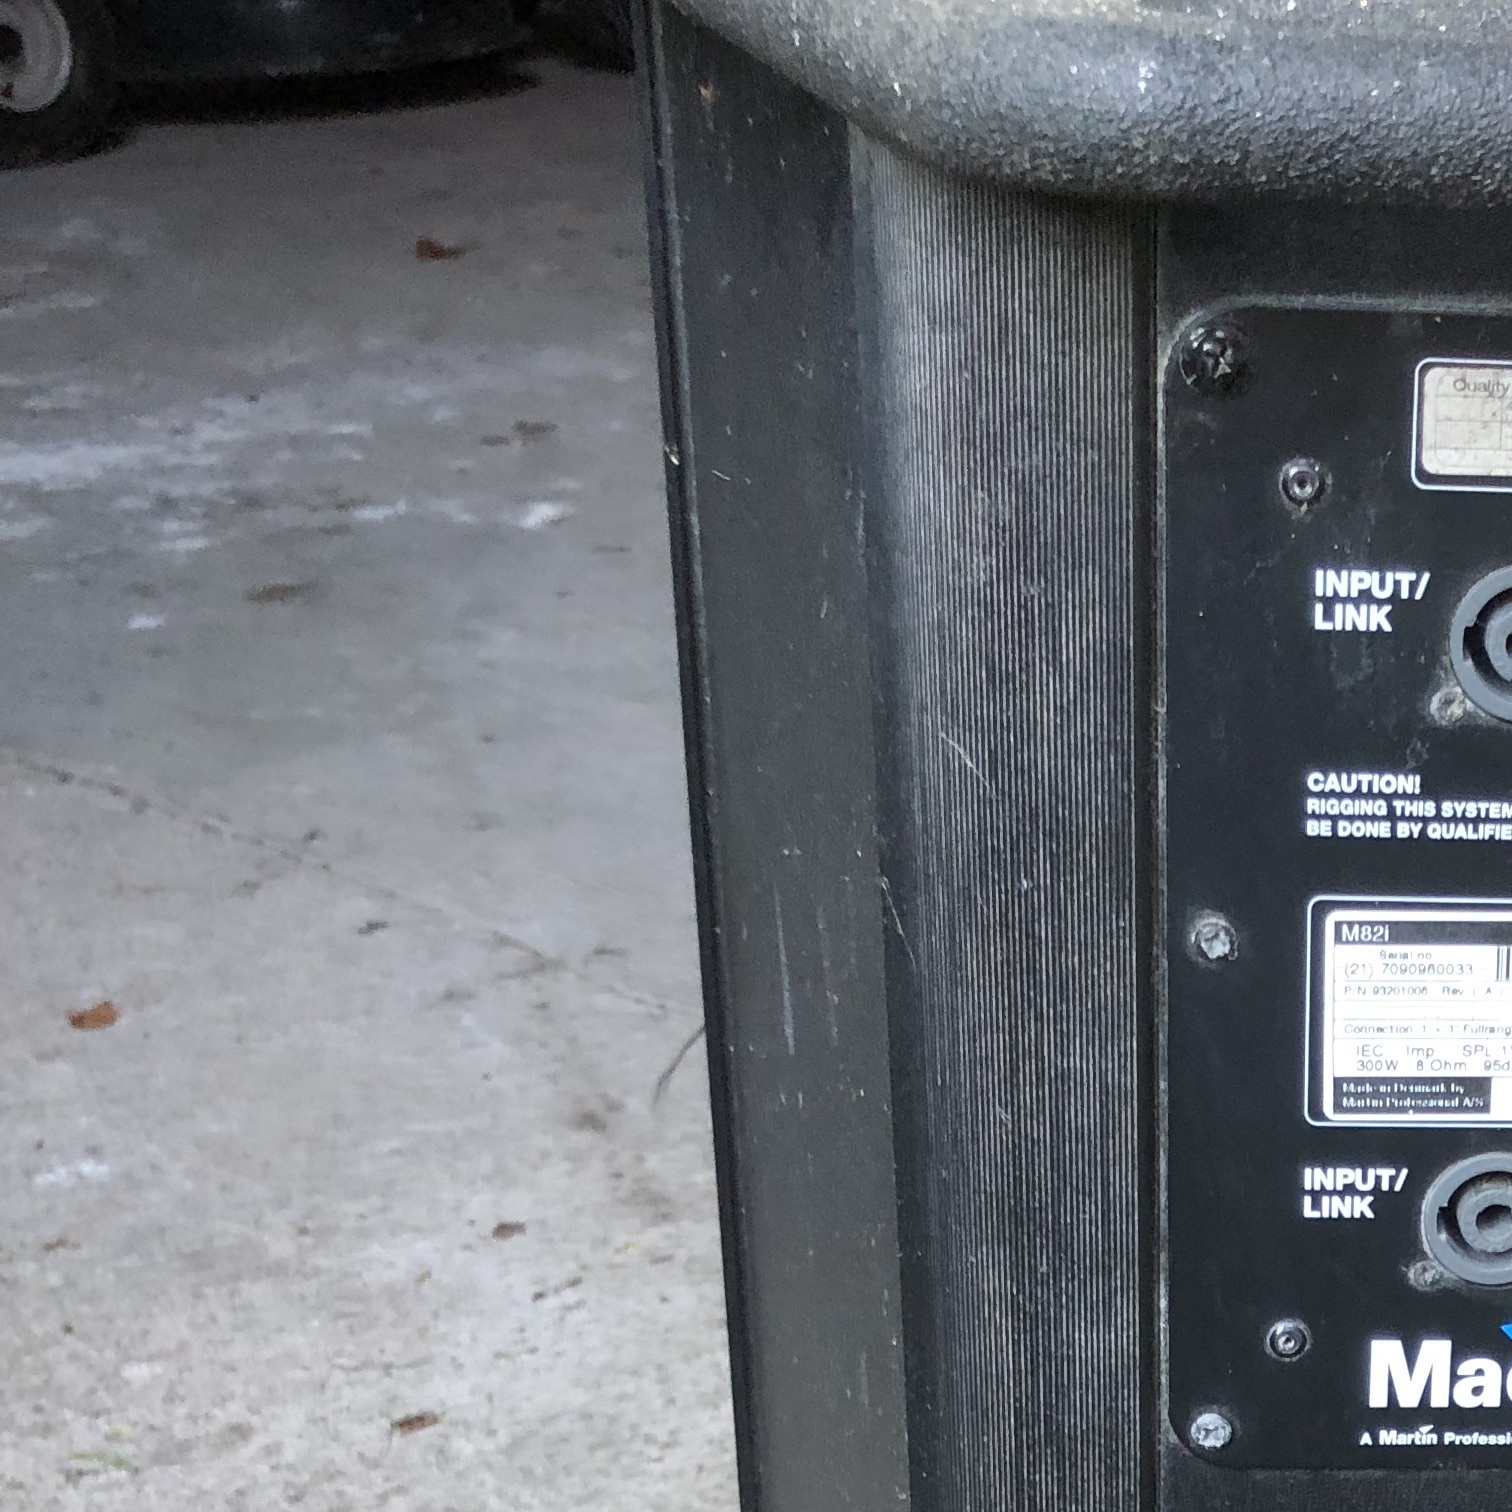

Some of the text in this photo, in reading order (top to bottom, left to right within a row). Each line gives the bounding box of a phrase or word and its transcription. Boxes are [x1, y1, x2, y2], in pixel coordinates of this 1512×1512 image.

[1452, 377, 1511, 398] Quality
[1314, 568, 1431, 600] INPUT/
[1314, 602, 1393, 632] LINK
[1307, 772, 1421, 794] CAUTION!
[1306, 799, 1388, 817] RIGGING
[1393, 800, 1436, 818] THIS
[1306, 820, 1332, 837] BE
[1337, 821, 1392, 838] DONE
[1396, 822, 1422, 839] BY
[1341, 924, 1390, 942] M82i
[1344, 963, 1374, 979] (21)
[1344, 987, 1367, 996] PN
[1344, 1024, 1413, 1034] Connection
[1356, 1044, 1384, 1057] IEC
[1462, 1044, 1493, 1058] SPL
[1356, 1059, 1398, 1072] 300W
[1416, 1060, 1424, 1072] 8
[1430, 1059, 1467, 1072] Ohm
[1303, 1167, 1408, 1193] INPUT/
[1303, 1194, 1375, 1219] LINK
[1359, 1432, 1373, 1446] A
[1378, 1426, 1438, 1446] Martin
